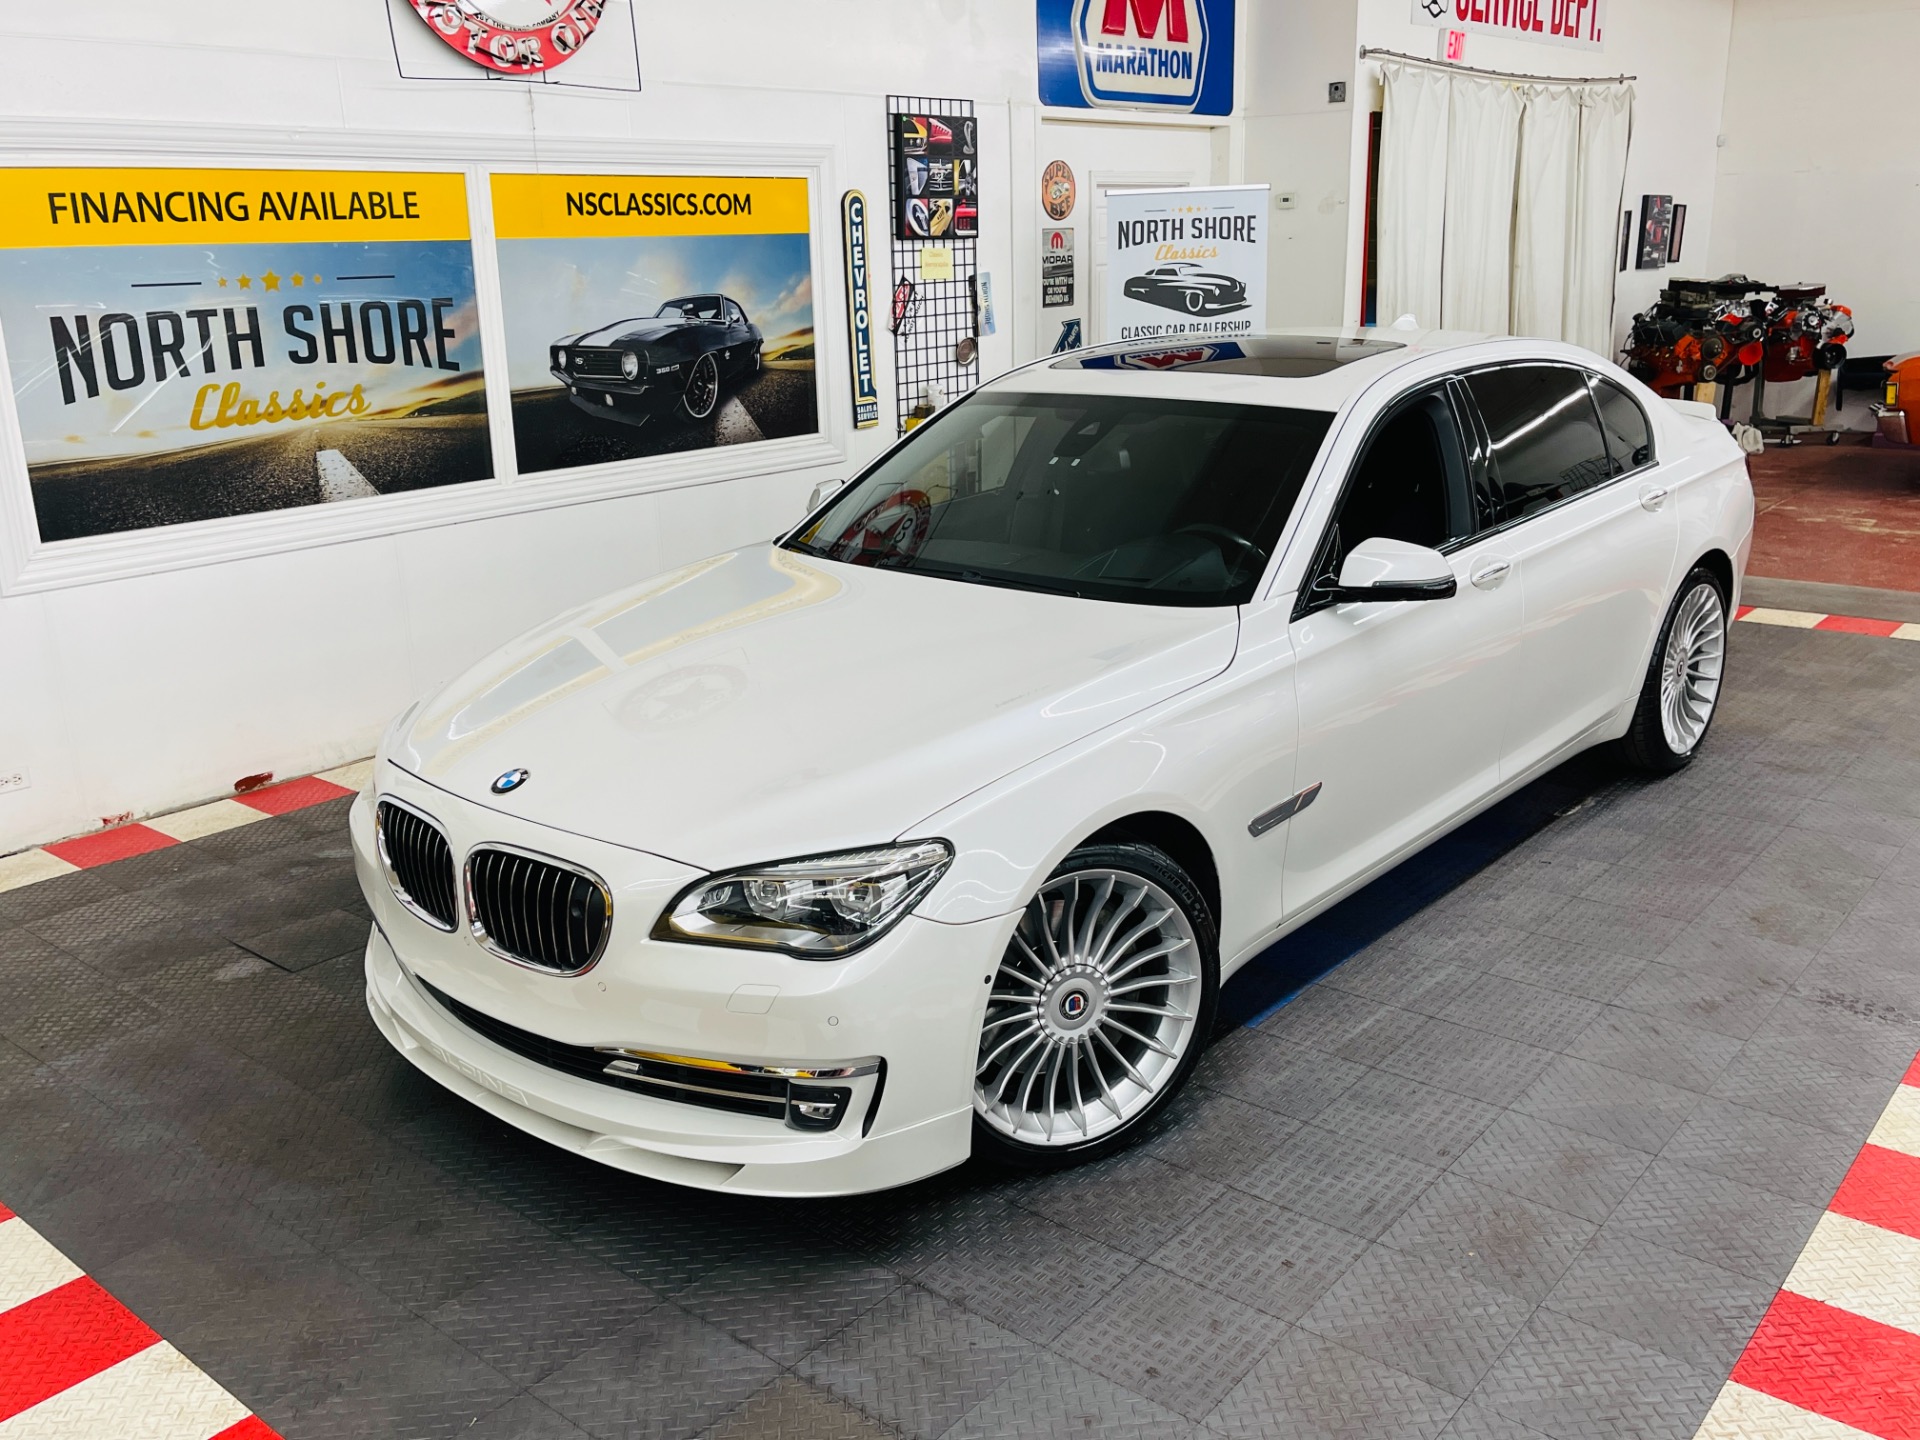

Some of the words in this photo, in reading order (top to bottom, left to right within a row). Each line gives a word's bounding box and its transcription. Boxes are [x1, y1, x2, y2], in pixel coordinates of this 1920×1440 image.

[1096, 42, 1193, 79] MARATHON
[47, 191, 249, 224] FINANCING
[259, 190, 420, 221] AVAILABLE
[566, 192, 752, 216] NSCLASSICS.COM
[1117, 218, 1184, 250] NORTH
[1191, 215, 1257, 244] SHORE
[1042, 255, 1073, 264] MOPAR
[1154, 244, 1219, 261] Classics
[850, 202, 871, 394] CHEVROLET
[1121, 324, 1163, 340] CLASSIC
[1166, 323, 1186, 334] CAR
[1189, 320, 1252, 333] DEALERSHIP
[49, 306, 265, 405] NORTH
[283, 297, 460, 372] SHORE
[189, 381, 371, 432] Classics
[856, 404, 873, 414] SALES
[857, 411, 878, 421] SERVICE
